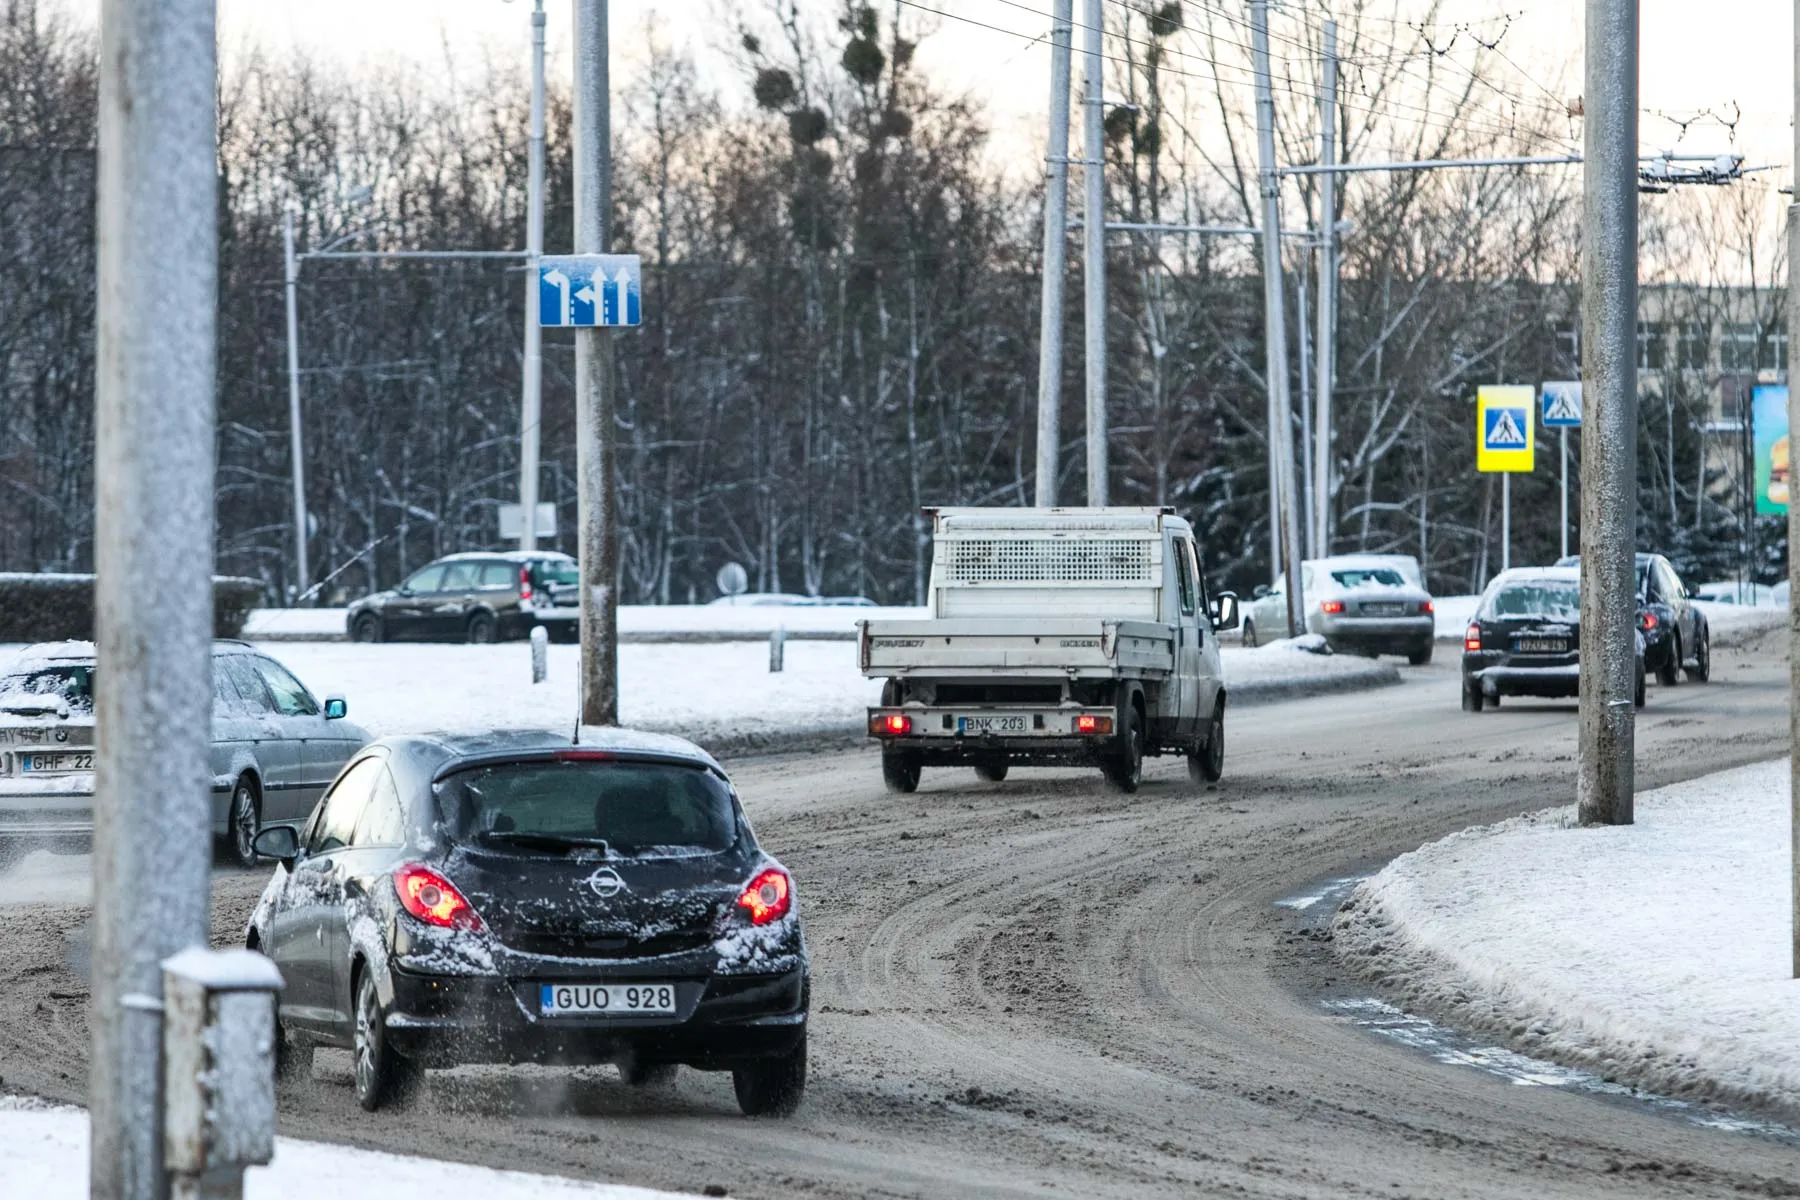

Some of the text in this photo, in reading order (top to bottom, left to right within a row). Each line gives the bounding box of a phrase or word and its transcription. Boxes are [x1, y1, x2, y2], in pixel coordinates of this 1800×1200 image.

[966, 718, 1024, 730] BNK 203
[33, 755, 96, 770] GHF 22
[556, 987, 671, 1009] GUO 928
